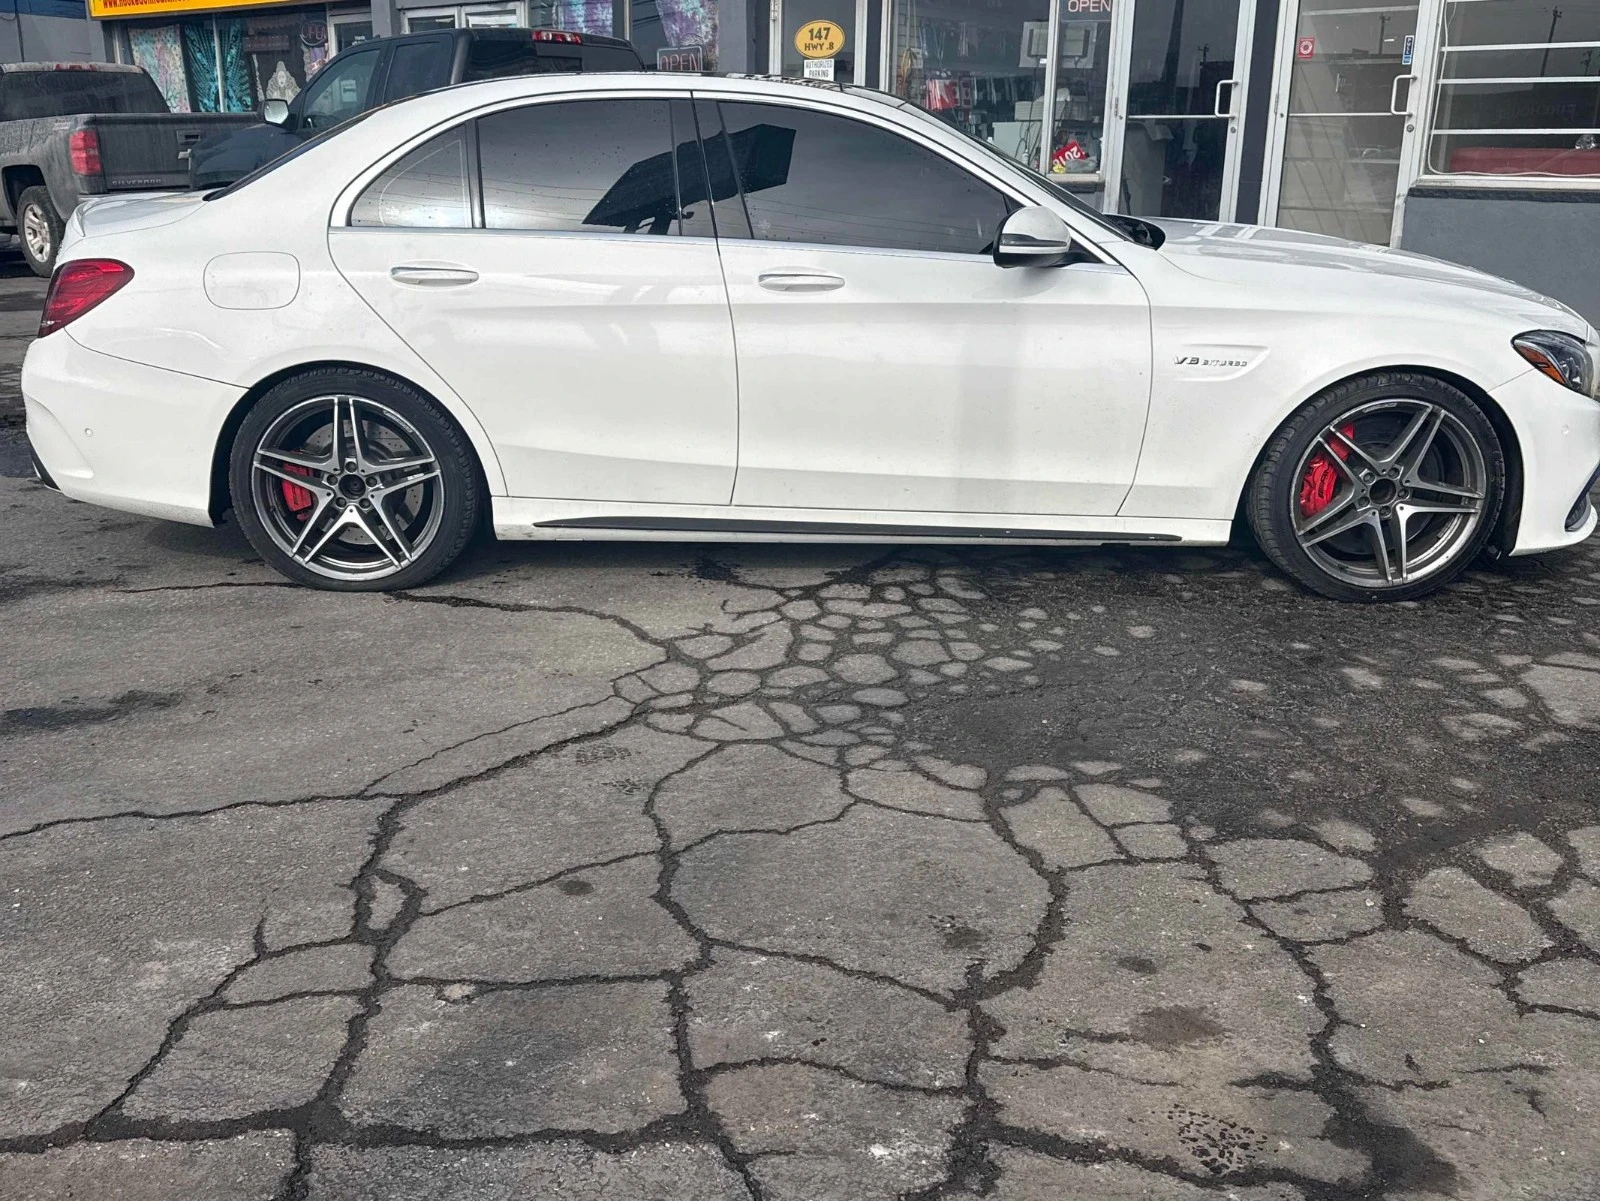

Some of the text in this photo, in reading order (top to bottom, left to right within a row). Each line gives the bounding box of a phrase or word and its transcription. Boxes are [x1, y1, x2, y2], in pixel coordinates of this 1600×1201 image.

[1068, 0, 1111, 12] OPEN
[808, 27, 831, 41] 147
[804, 42, 825, 51] HWY
[660, 53, 700, 71] OPEN
[806, 60, 833, 69] AUTHORIZED
[809, 69, 829, 78] PARKING
[1173, 357, 1248, 367] V8 BITURBO
